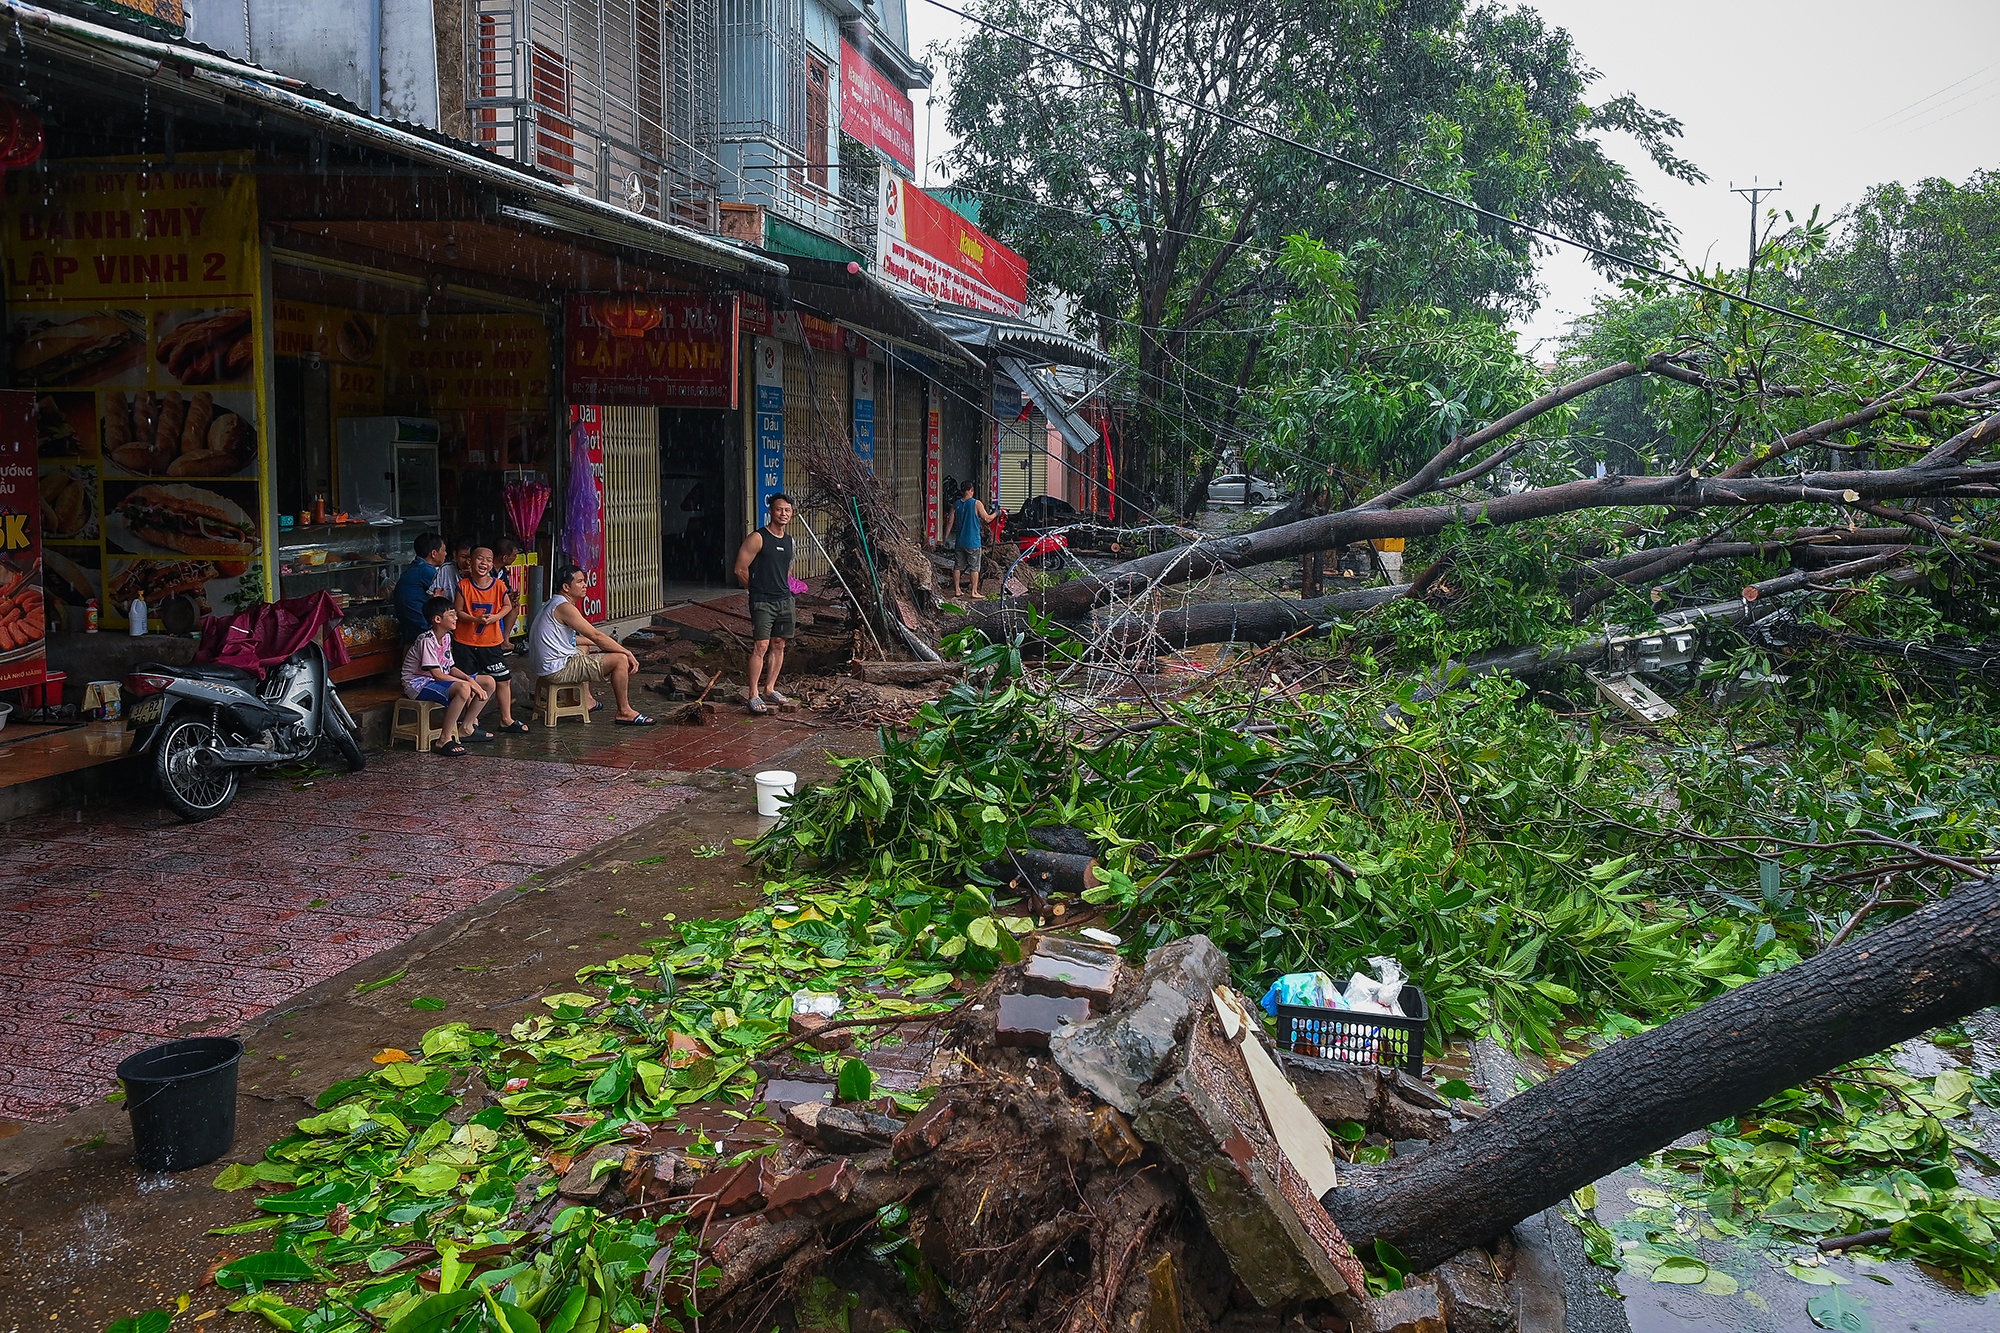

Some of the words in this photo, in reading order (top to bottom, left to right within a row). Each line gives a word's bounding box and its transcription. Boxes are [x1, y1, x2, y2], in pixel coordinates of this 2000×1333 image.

[8, 251, 79, 292] LẬP
[93, 253, 189, 284] VINH
[203, 252, 226, 282] 2
[645, 341, 724, 369] VINH
[340, 371, 376, 394] 202
[761, 435, 780, 453] Thủy
[763, 455, 780, 472] Lực
[583, 596, 602, 616] Con
[471, 602, 495, 635] 7
